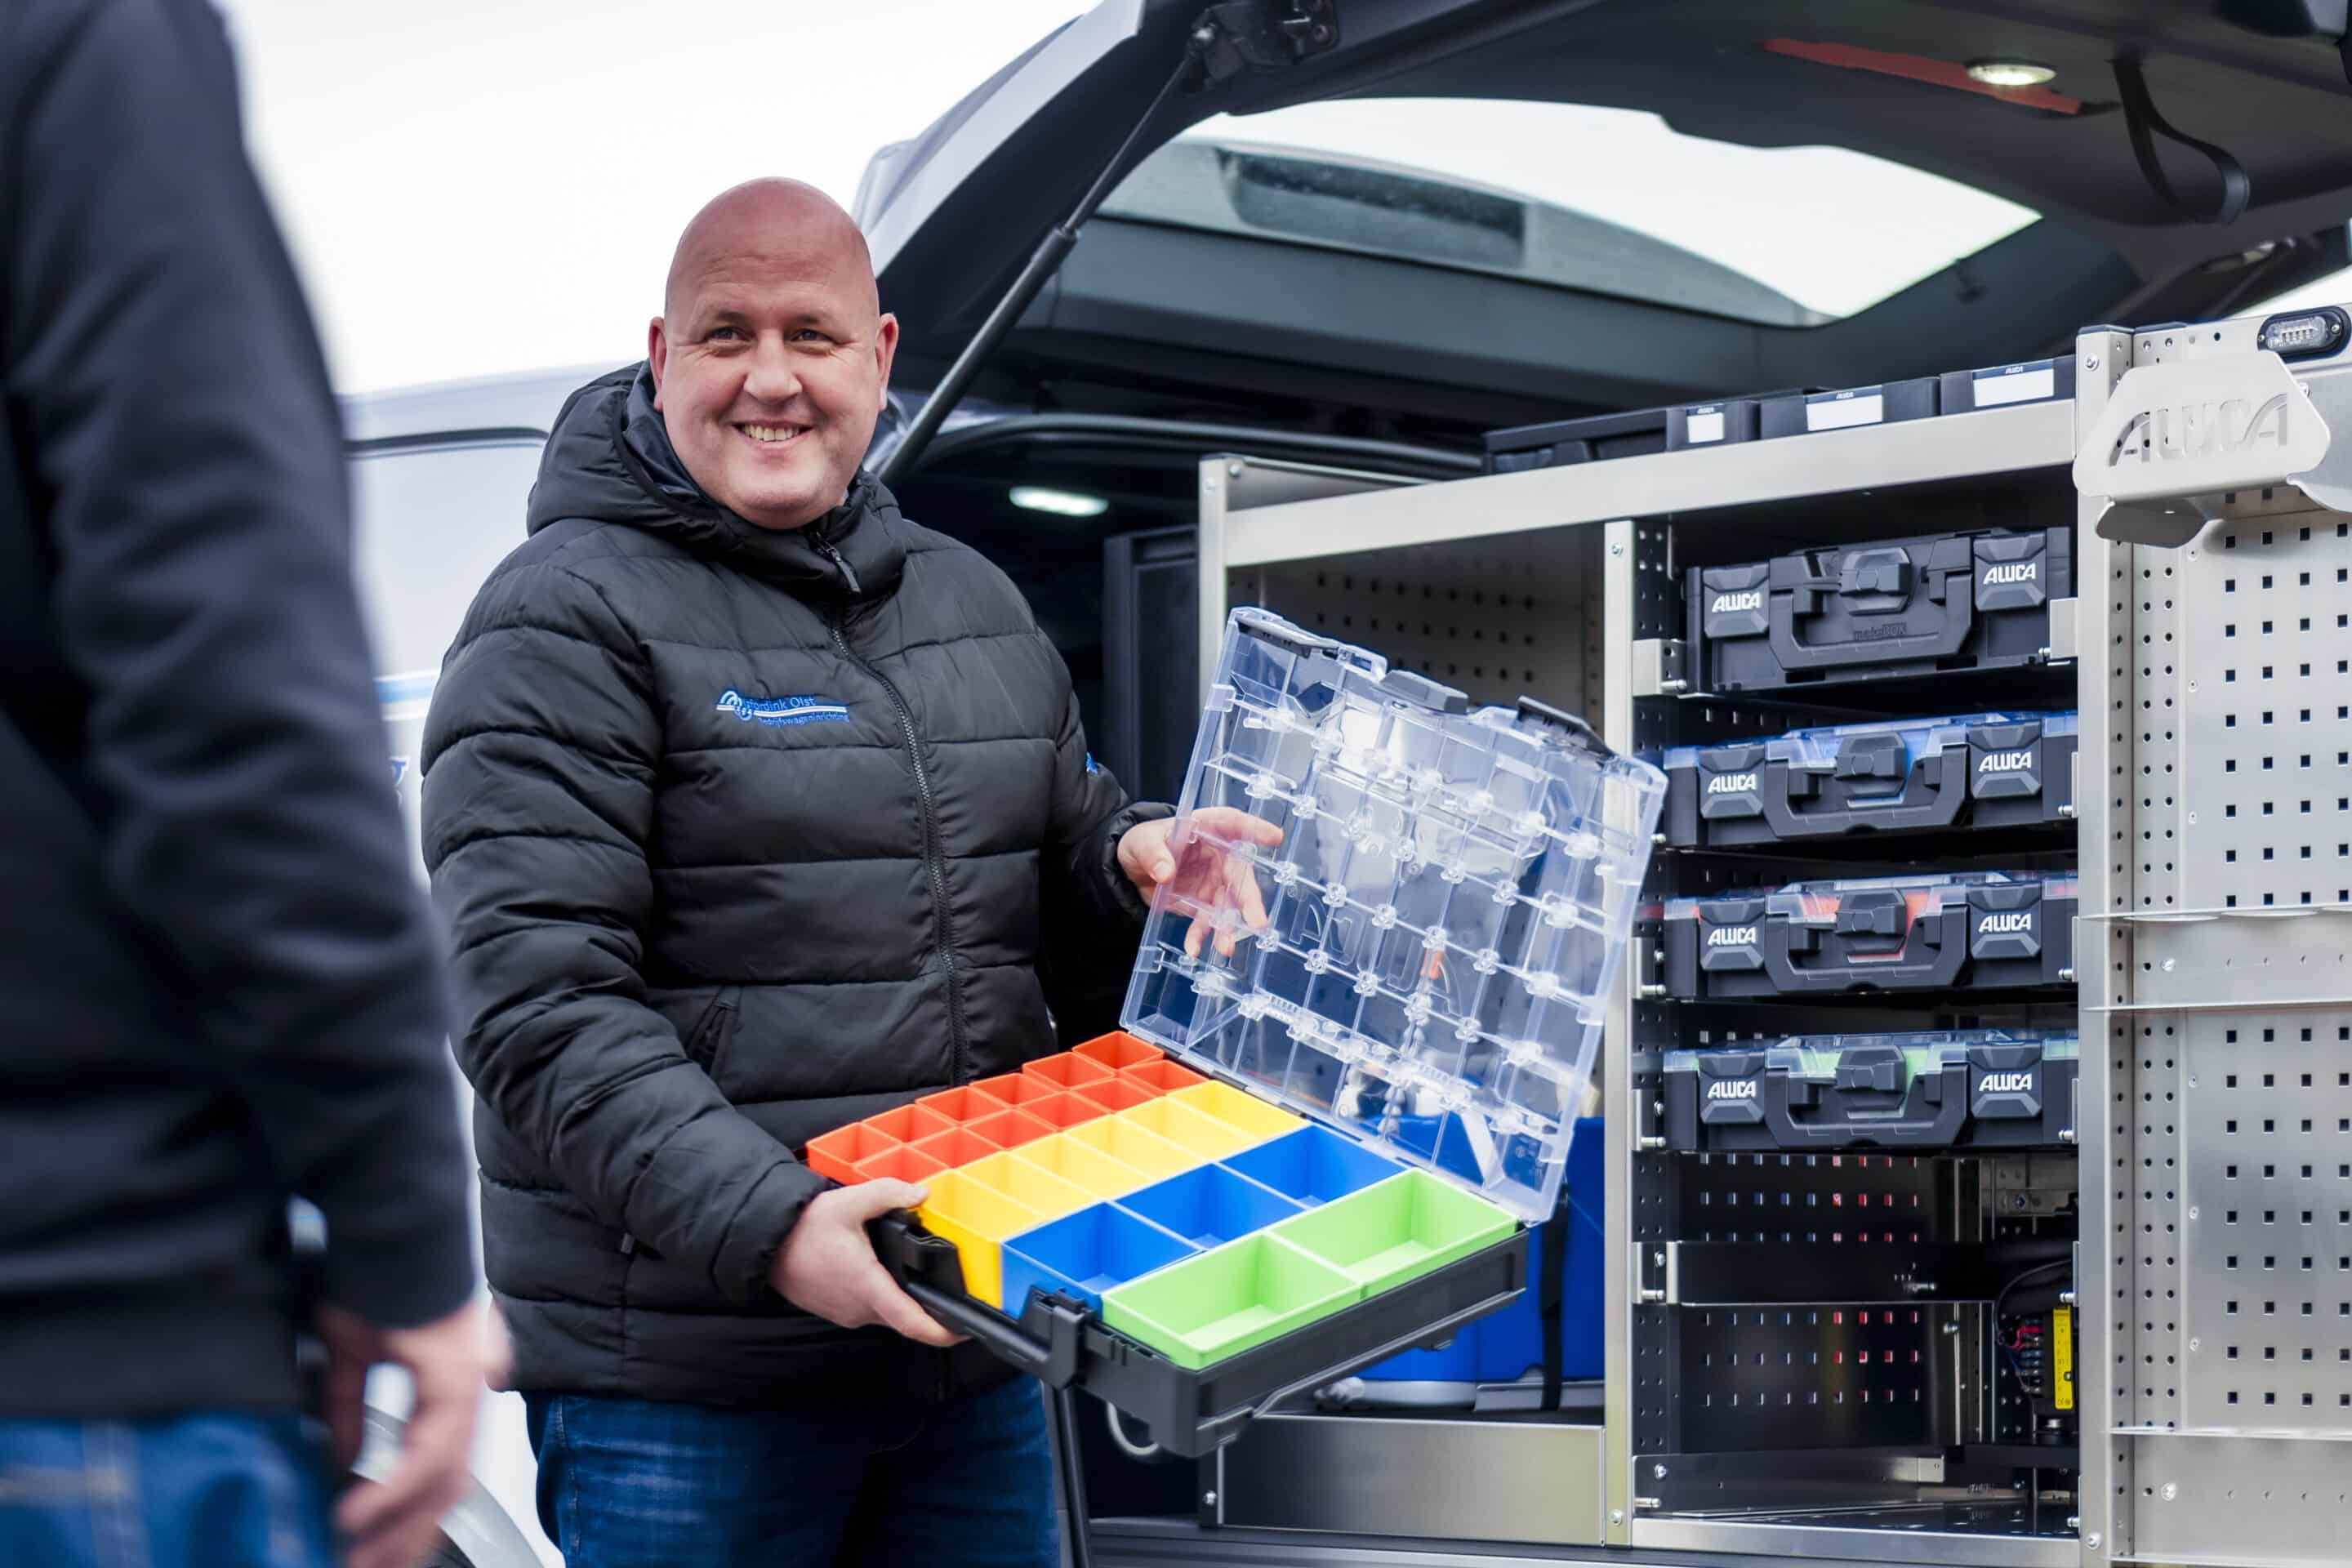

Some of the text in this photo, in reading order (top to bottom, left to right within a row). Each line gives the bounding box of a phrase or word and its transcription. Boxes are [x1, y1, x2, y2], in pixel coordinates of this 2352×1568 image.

[2109, 394, 2287, 467] ALUCA
[1982, 562, 2036, 584] ALUCA
[1712, 592, 1762, 612] ALUCA
[1979, 751, 2032, 772] ALUCA
[1708, 773, 1757, 793] ALUCA
[1979, 913, 2032, 933] ALUCA
[1708, 927, 1757, 946] ALUCA
[1708, 1080, 1757, 1098] ALUCA
[1979, 1073, 2032, 1092] ALUCA
